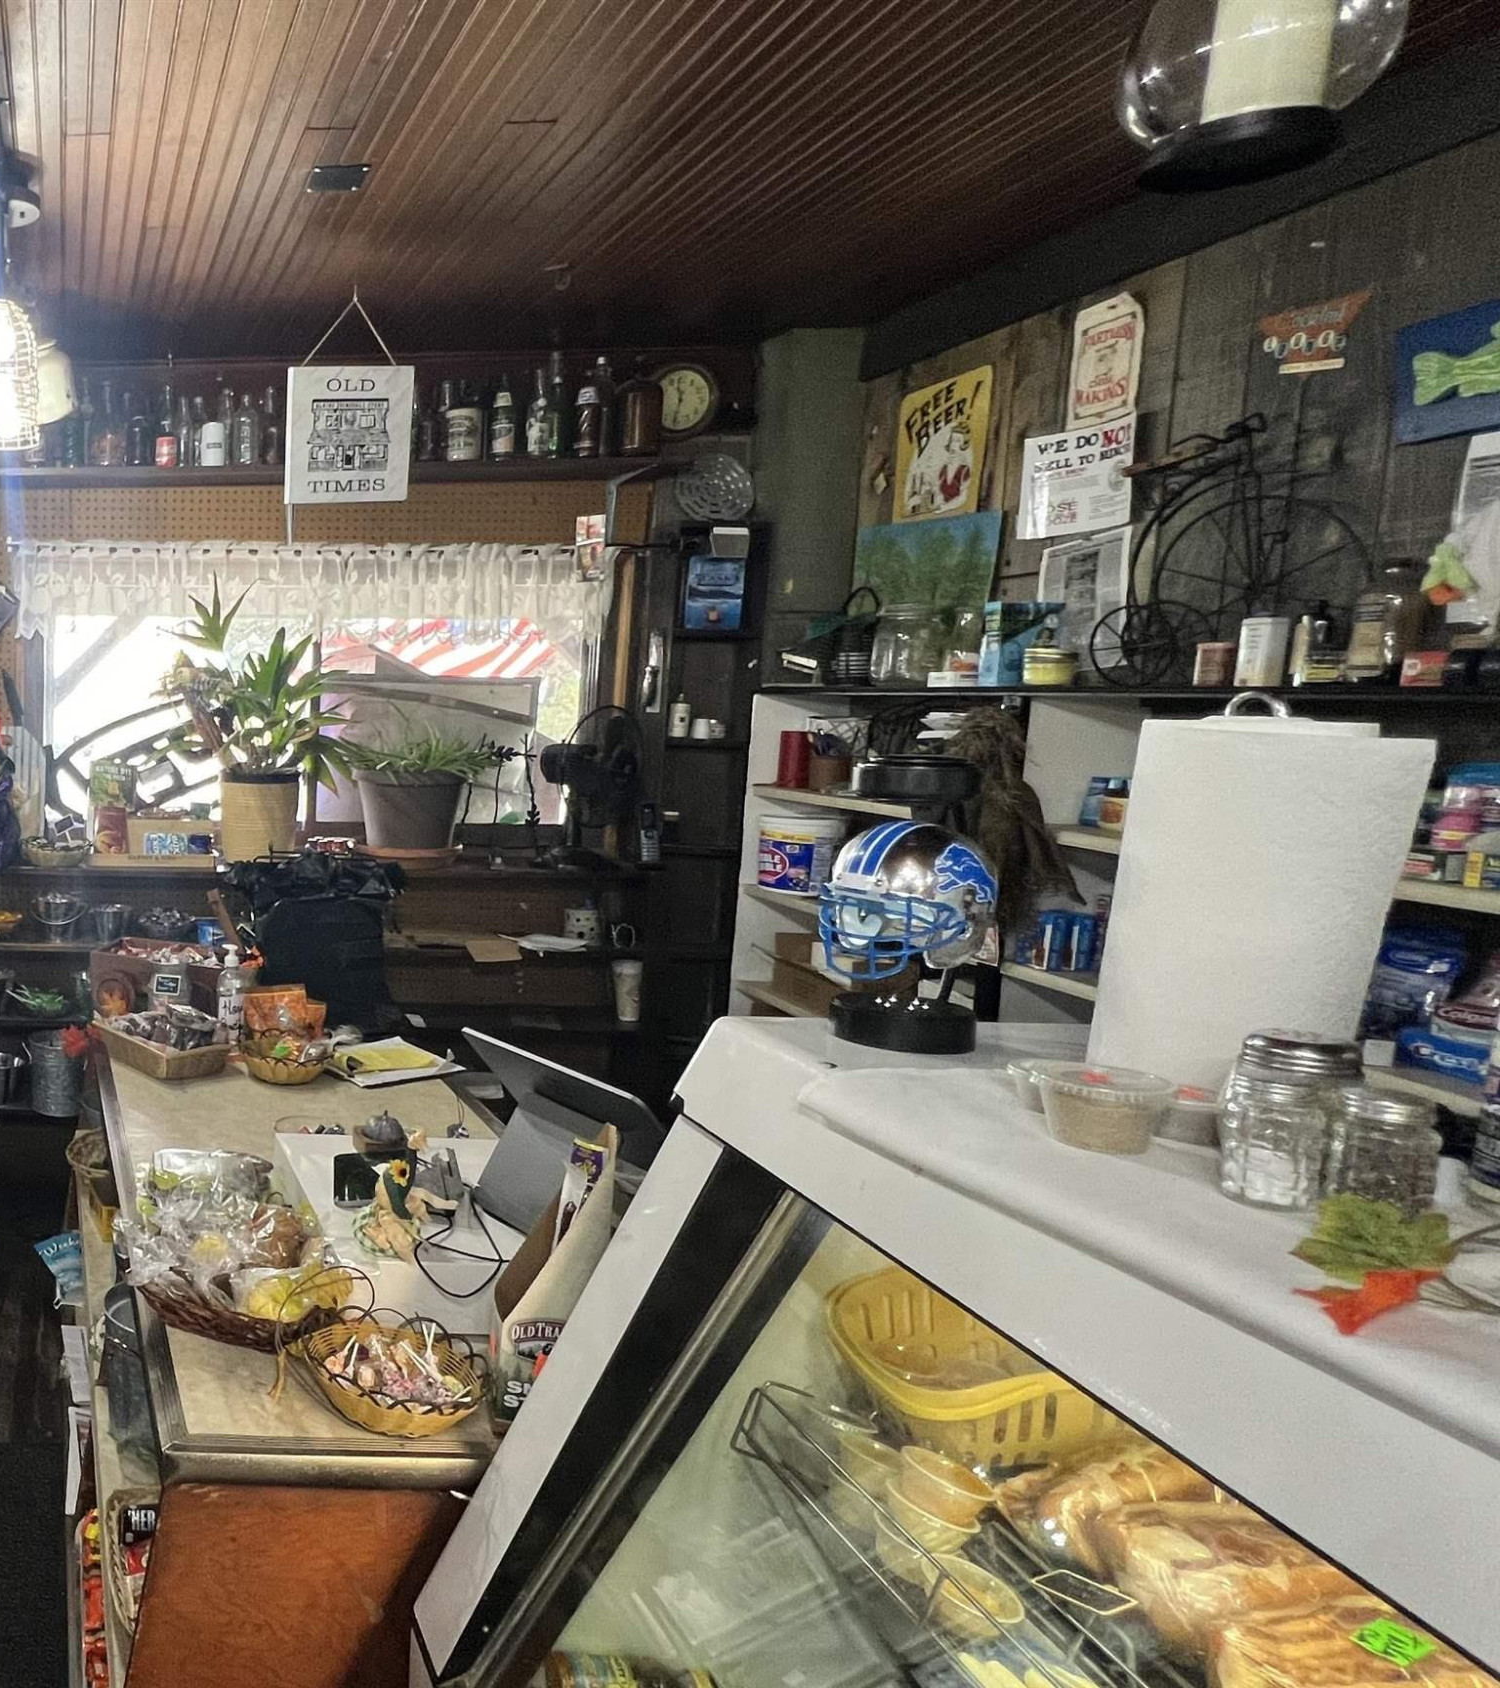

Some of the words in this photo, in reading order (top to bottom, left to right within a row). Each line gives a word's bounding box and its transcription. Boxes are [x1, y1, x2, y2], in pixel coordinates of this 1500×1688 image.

[326, 378, 376, 392] OLD
[905, 381, 957, 445] FREE
[1037, 439, 1068, 455] WE
[1075, 433, 1099, 450] DO
[1079, 454, 1095, 466] TO
[307, 478, 385, 493] TIMES
